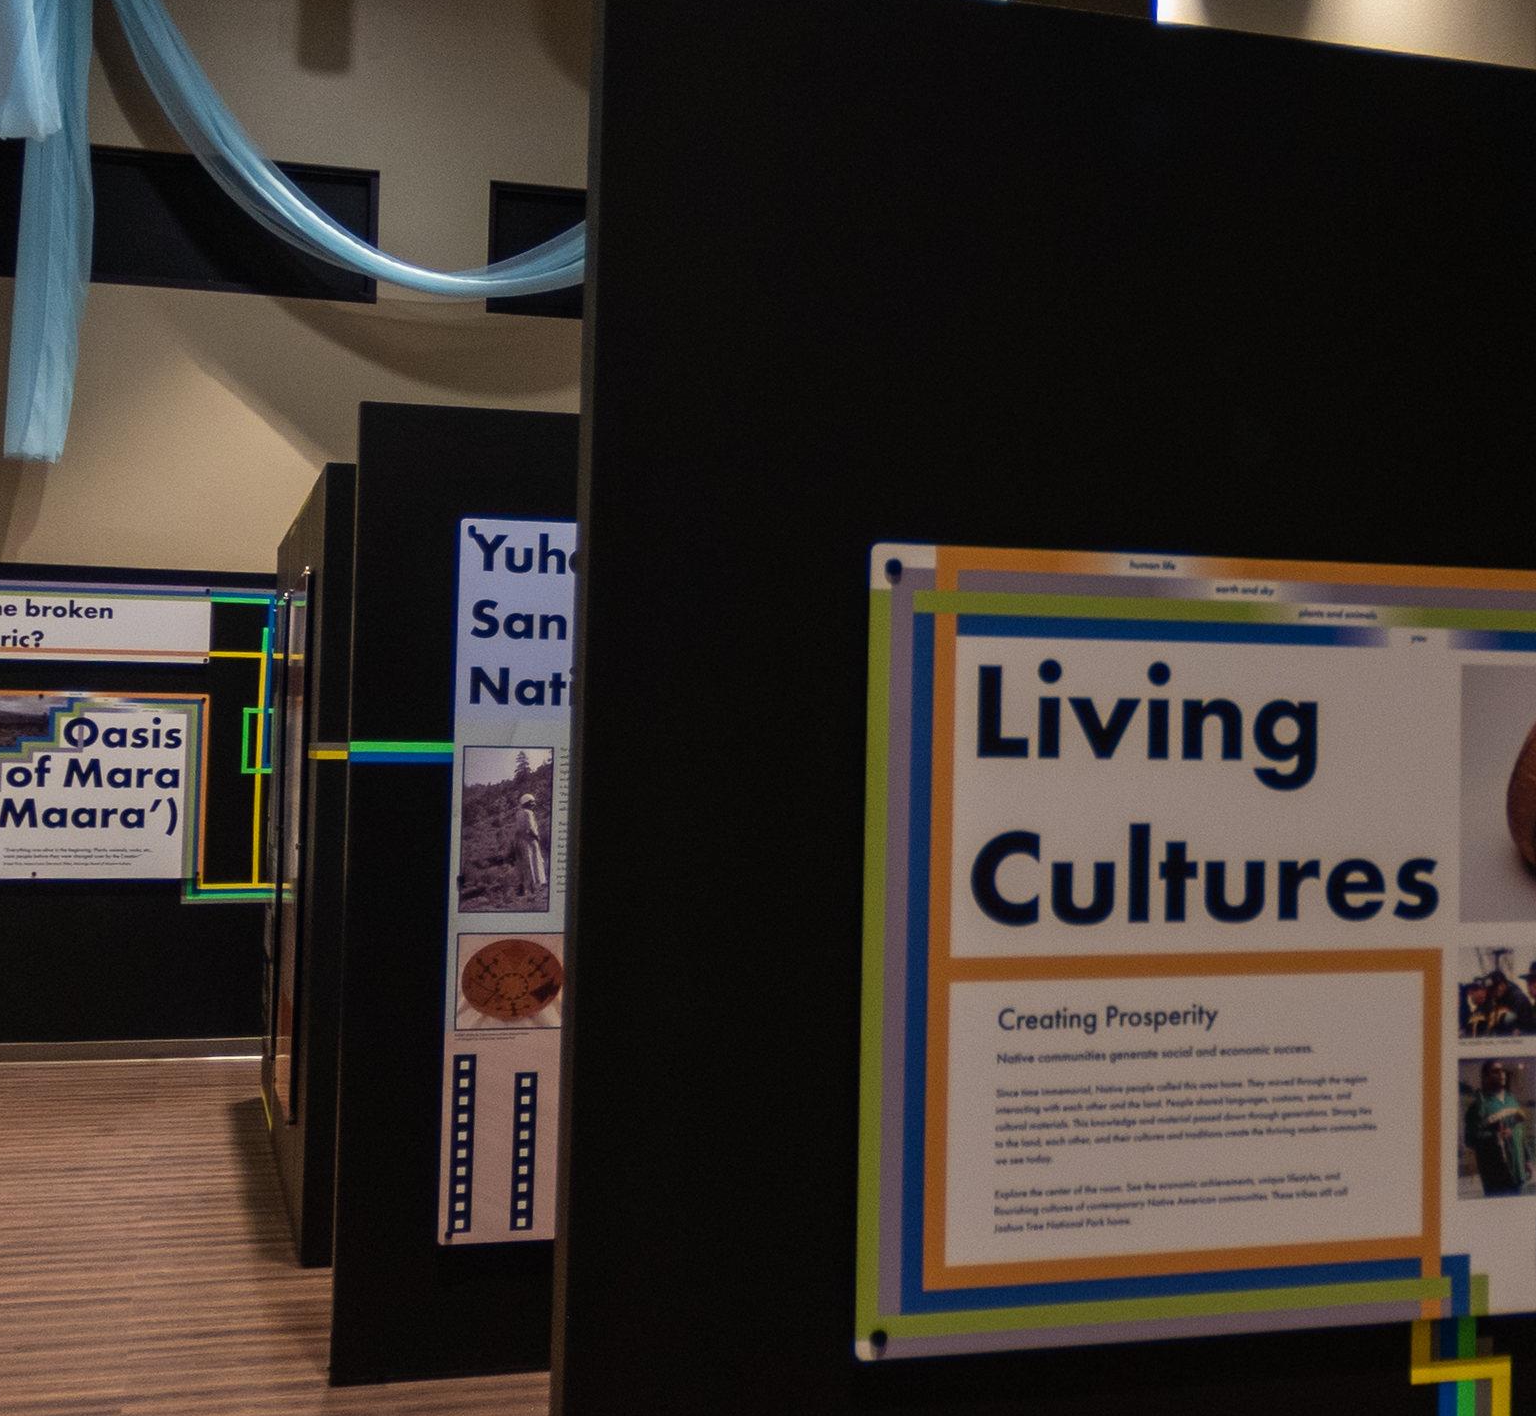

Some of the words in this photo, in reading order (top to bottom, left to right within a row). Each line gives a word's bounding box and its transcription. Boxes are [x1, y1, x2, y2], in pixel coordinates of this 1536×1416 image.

[25, 593, 113, 619] broken
[471, 599, 567, 640] San
[63, 716, 182, 750] Oasis
[977, 659, 1319, 791] Living
[6, 754, 51, 787] of
[63, 758, 179, 789] Mara
[970, 823, 1440, 927] Cultures
[998, 1007, 1097, 1035] Creating
[1105, 1003, 1218, 1032] Prosperity
[996, 1053, 1035, 1064] Native
[1037, 1050, 1106, 1063] communities
[1108, 1049, 1159, 1064] generate
[1161, 1045, 1193, 1058] social
[1195, 1045, 1217, 1057] and
[1218, 1045, 1270, 1056] economic
[1273, 1045, 1313, 1054] success.
